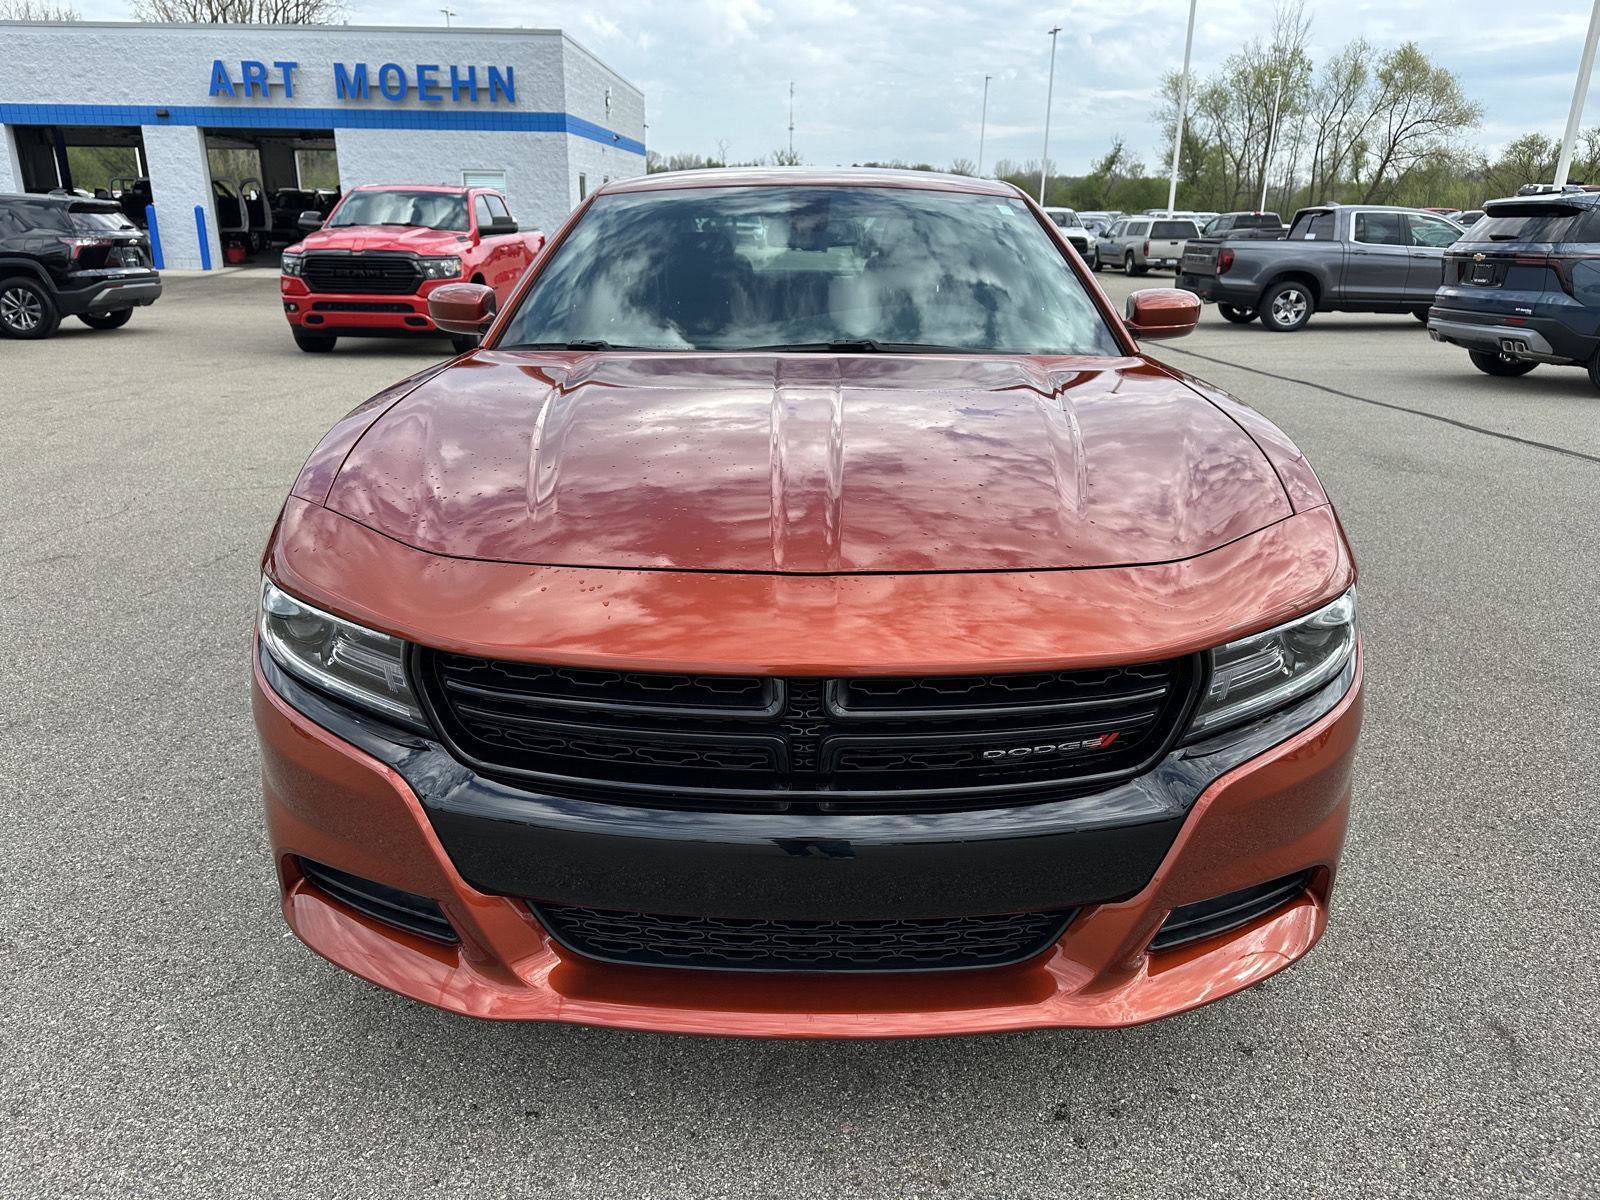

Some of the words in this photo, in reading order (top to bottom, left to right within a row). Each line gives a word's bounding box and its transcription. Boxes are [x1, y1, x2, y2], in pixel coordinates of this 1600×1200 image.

[208, 60, 298, 98] ART
[333, 62, 516, 103] MOEHN
[983, 737, 1103, 759] DODGE
